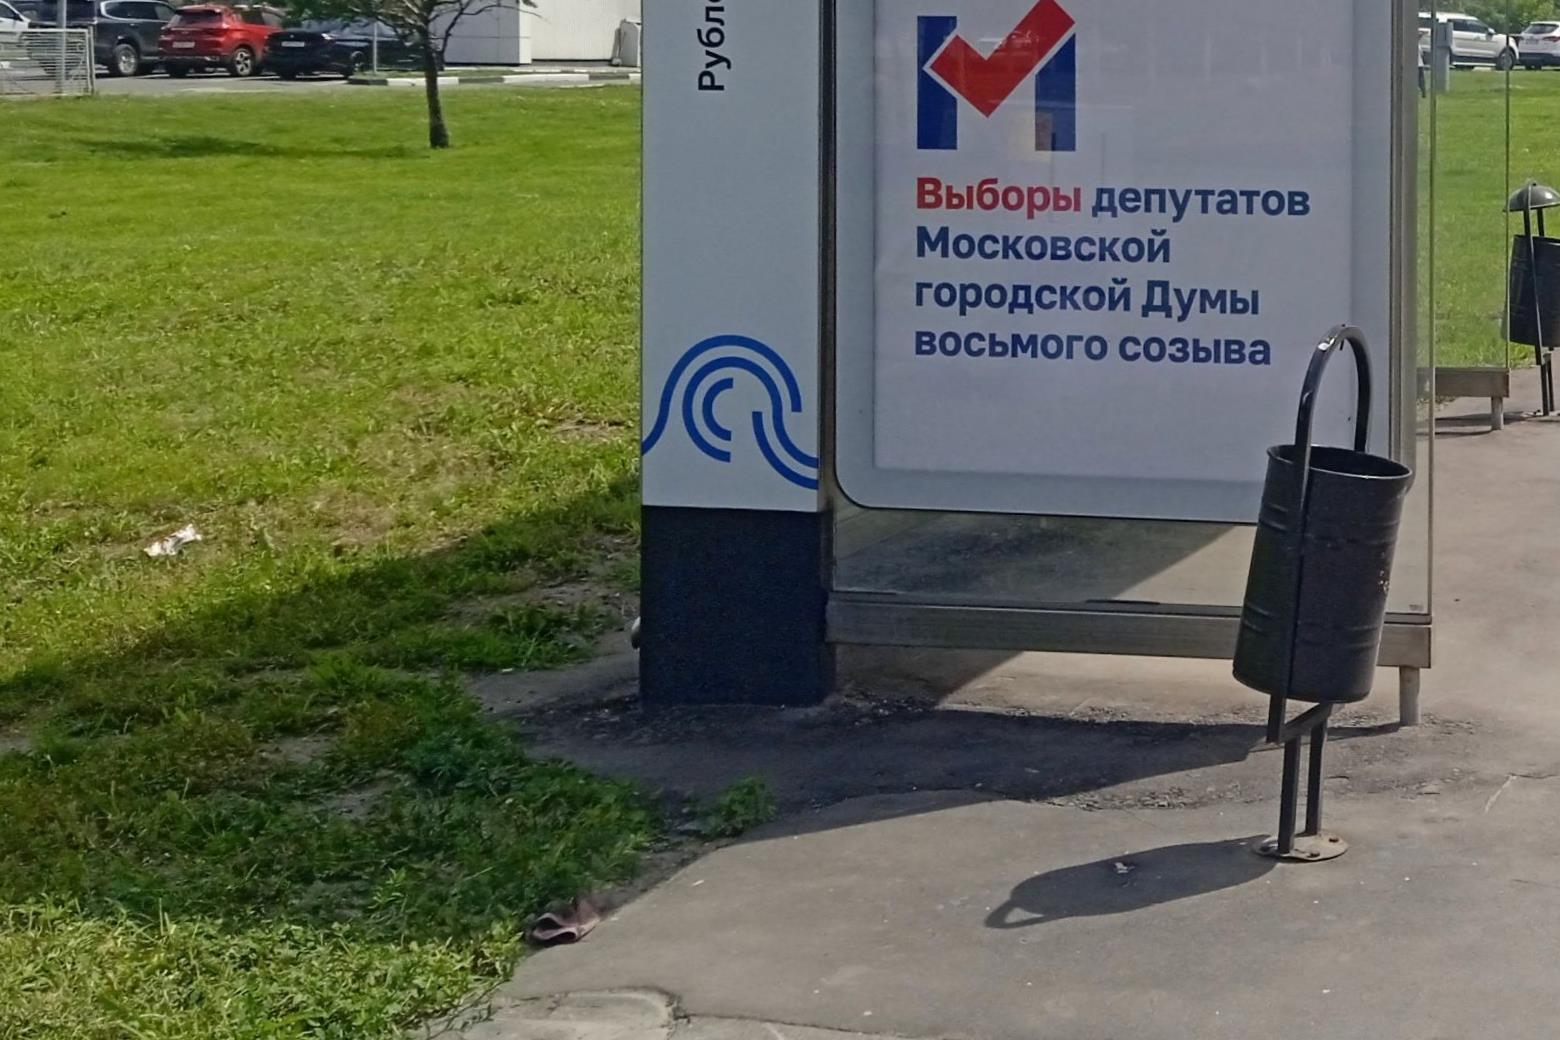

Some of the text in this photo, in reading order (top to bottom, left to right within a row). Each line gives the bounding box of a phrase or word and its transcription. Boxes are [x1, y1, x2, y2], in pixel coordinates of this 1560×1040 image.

[917, 177, 1310, 221] Выборы депутатов
[917, 226, 1170, 263] Московской
[916, 277, 1259, 320] городской Думы
[916, 331, 1272, 367] восьмого созыва
